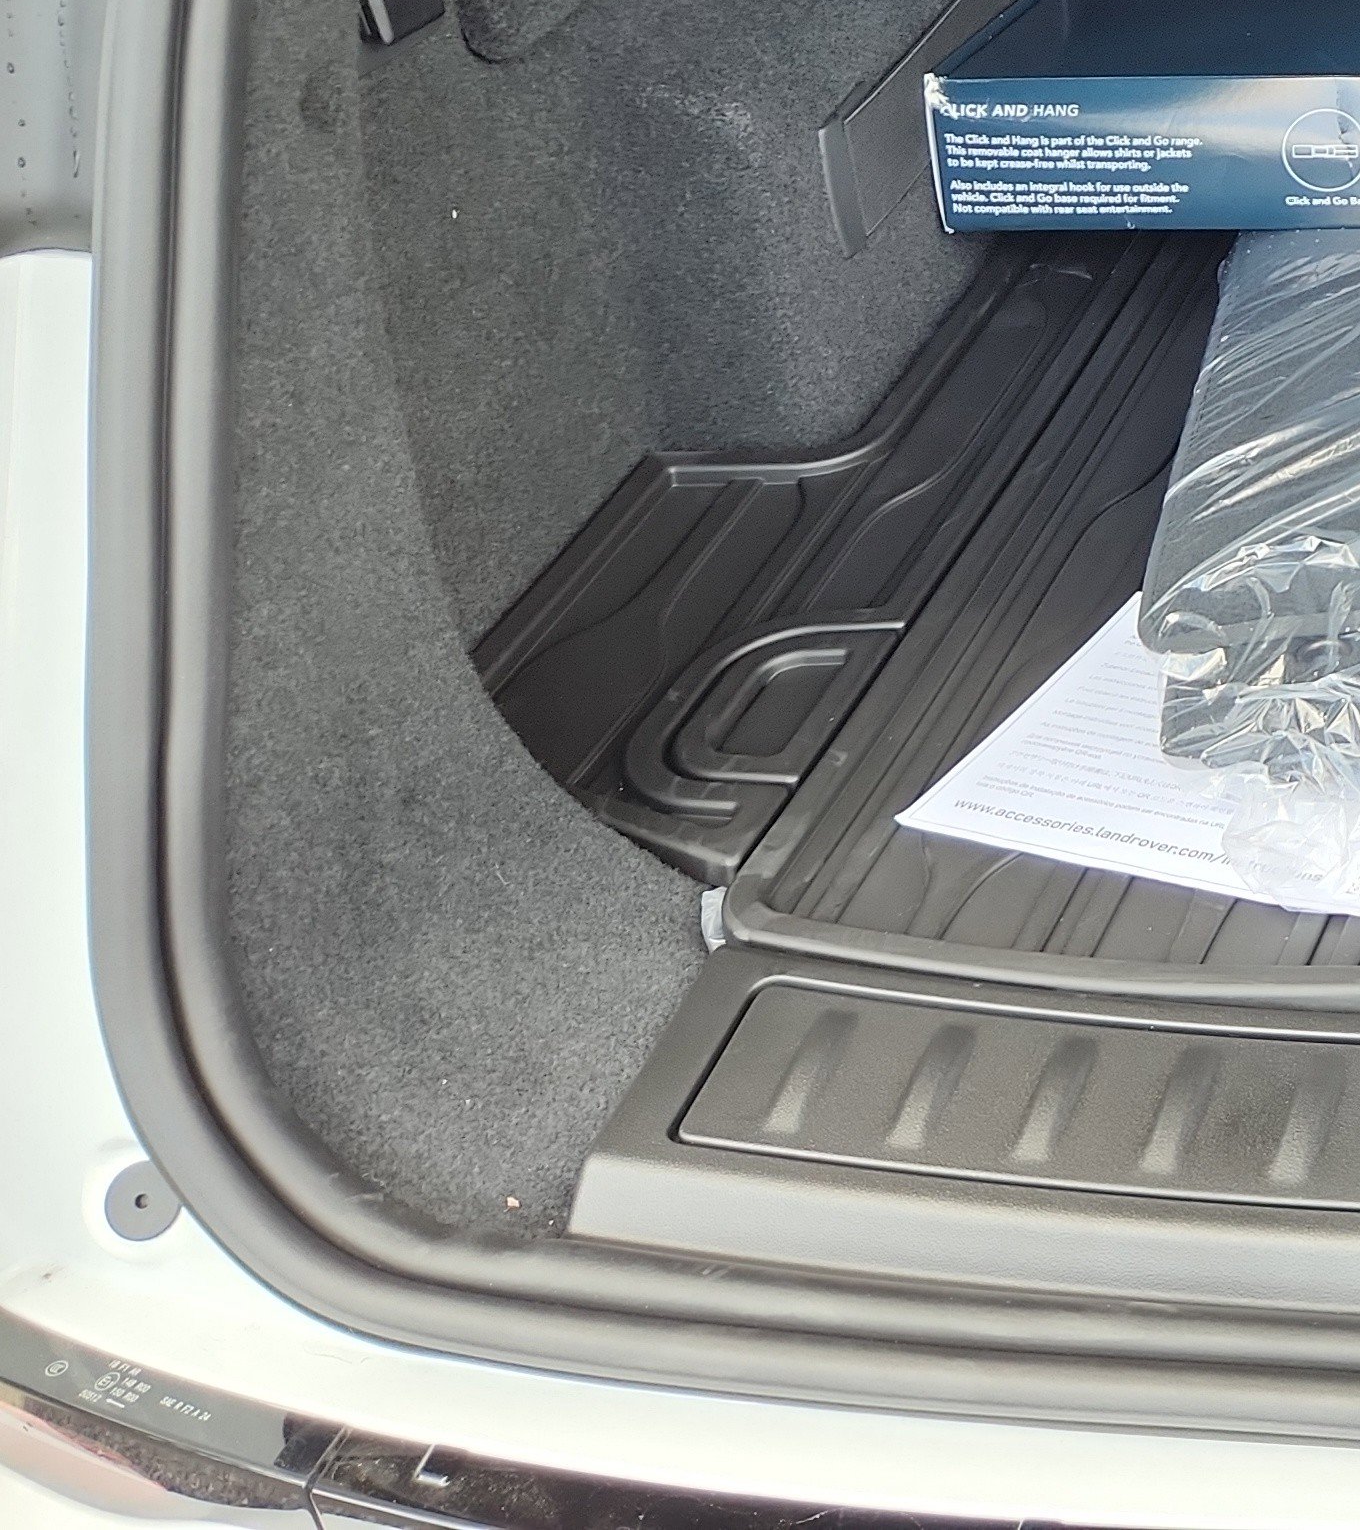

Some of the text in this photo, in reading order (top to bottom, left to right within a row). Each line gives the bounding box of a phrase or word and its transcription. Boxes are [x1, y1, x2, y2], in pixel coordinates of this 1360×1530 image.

[940, 104, 1079, 119] CLICK AND HANG
[944, 133, 1203, 148] The Click and Hang is part of the Click and Go range.
[946, 144, 1193, 161] This removable coat hanger allows shirts or jackets
[947, 157, 959, 167] to
[960, 157, 974, 168] be
[975, 157, 999, 170] kept
[1056, 159, 1086, 169] whilst
[1087, 159, 1152, 172] transporting.
[950, 179, 973, 190] Also
[973, 180, 1014, 191] includes
[1015, 183, 1028, 191] an
[1069, 181, 1095, 192] hook
[1096, 181, 1112, 192] for
[1113, 184, 1131, 192] use
[1132, 183, 1170, 192] outside
[1171, 183, 1190, 192] the
[951, 191, 1180, 205] vehicle. Click and Go base required for fitment.
[1285, 196, 1311, 206] Click
[1312, 196, 1331, 206] and
[1332, 196, 1349, 206] Go
[953, 202, 1173, 216] Not compatible with rear seat entertainment.
